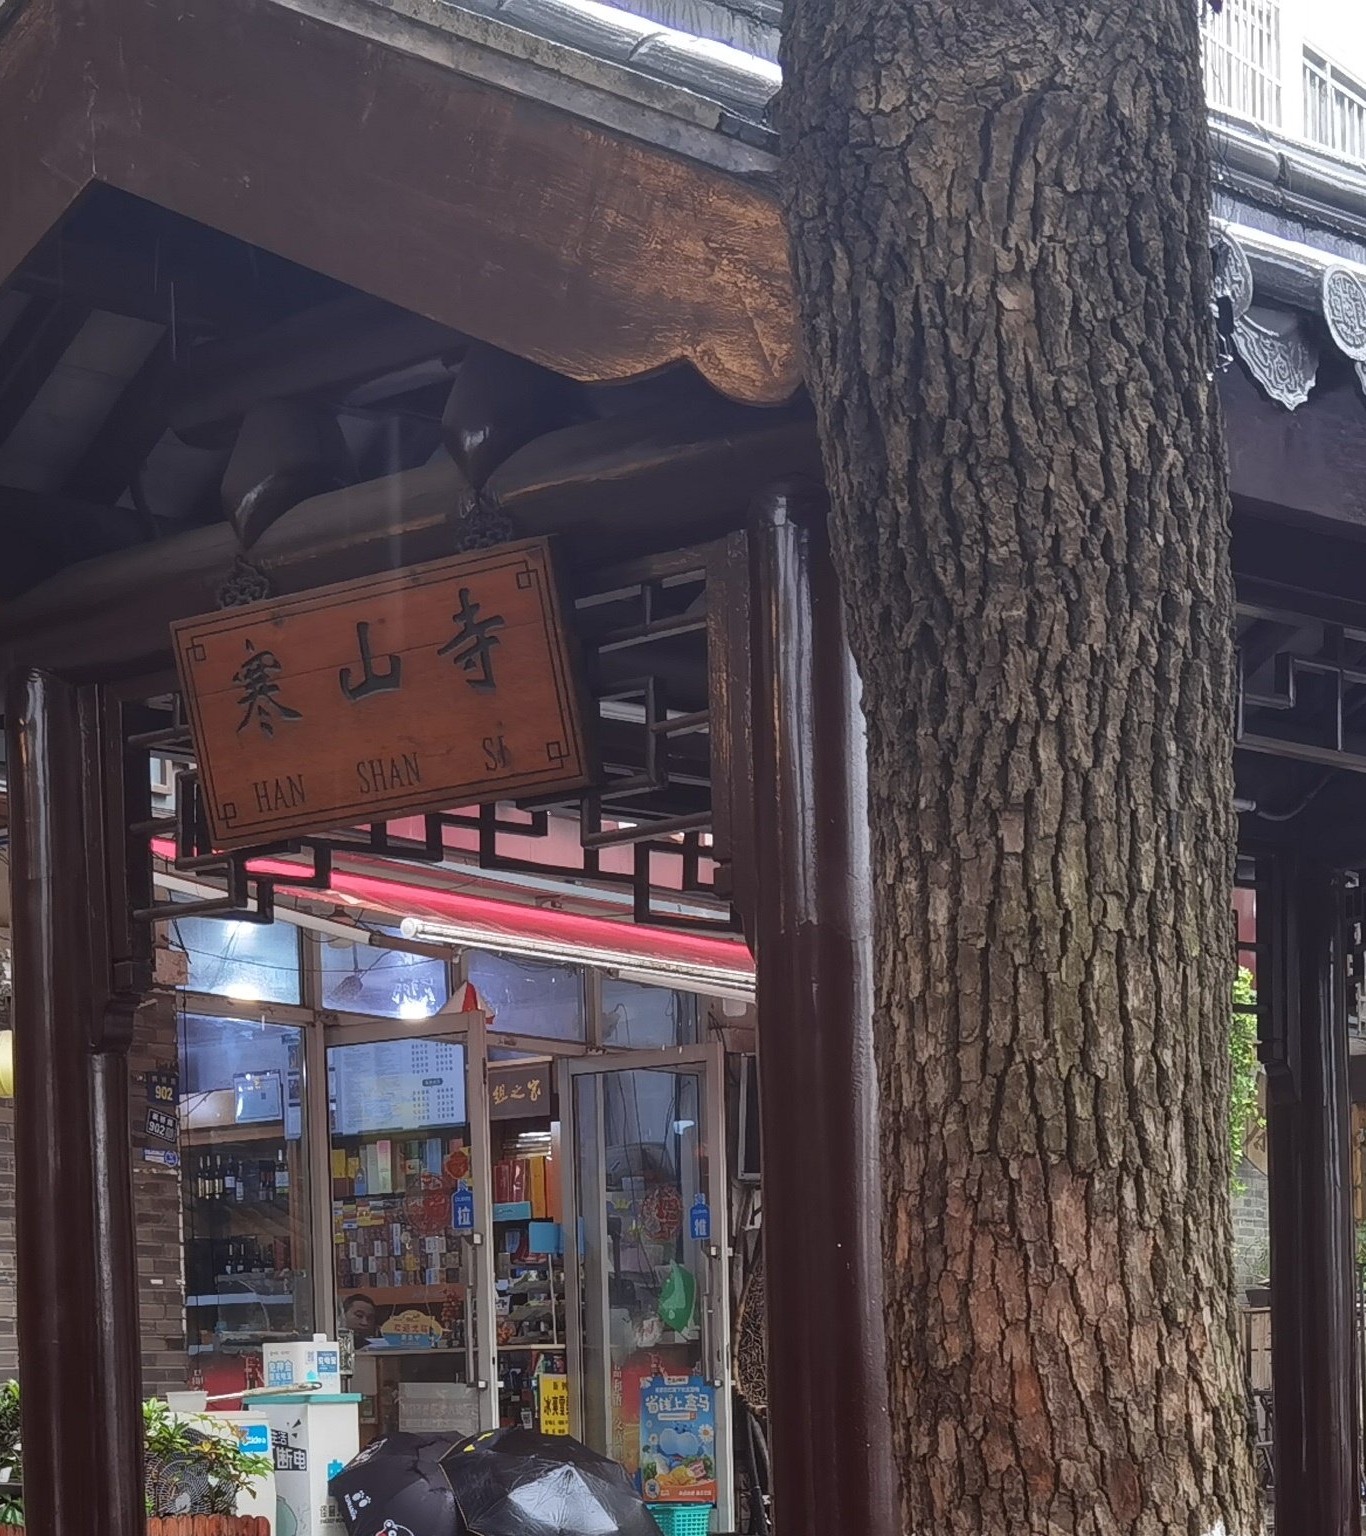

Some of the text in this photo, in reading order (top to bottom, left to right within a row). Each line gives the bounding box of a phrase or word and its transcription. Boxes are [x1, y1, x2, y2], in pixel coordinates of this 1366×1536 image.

[233, 588, 505, 737] 寒山寺
[253, 775, 306, 813] HAN
[356, 752, 421, 793] SHAN
[155, 1085, 173, 1101] 902
[148, 1121, 166, 1136] 902
